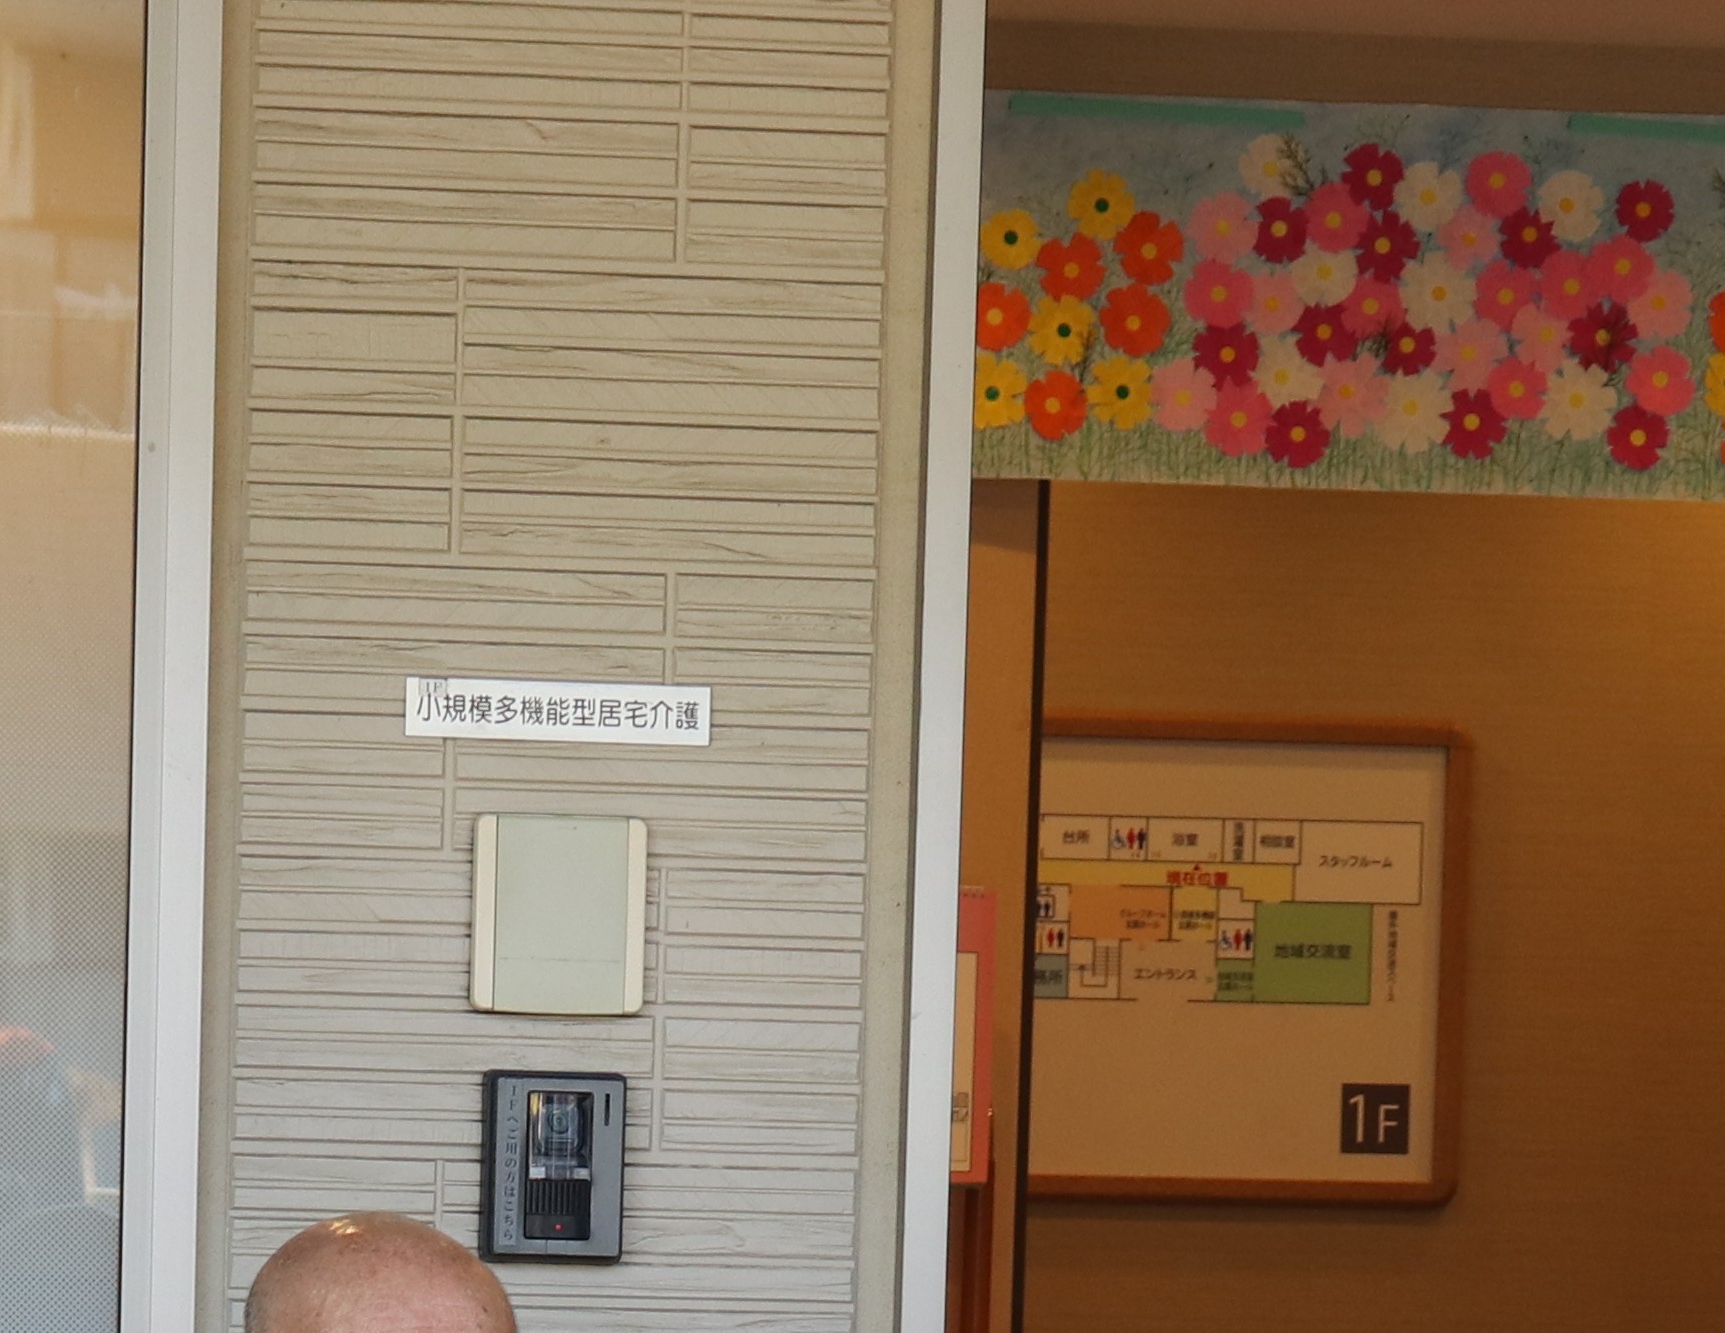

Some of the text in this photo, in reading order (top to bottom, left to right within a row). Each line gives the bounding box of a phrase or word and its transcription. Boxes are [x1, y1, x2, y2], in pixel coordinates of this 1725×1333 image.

[416, 693, 700, 732] 小規模多機能型居宅介護
[1318, 855, 1393, 868] スタッフルーム
[1166, 871, 1228, 886] 現在位置
[1274, 944, 1353, 960] 地域交流室
[1134, 968, 1197, 981] エントランス
[1348, 1094, 1400, 1144] 1F
